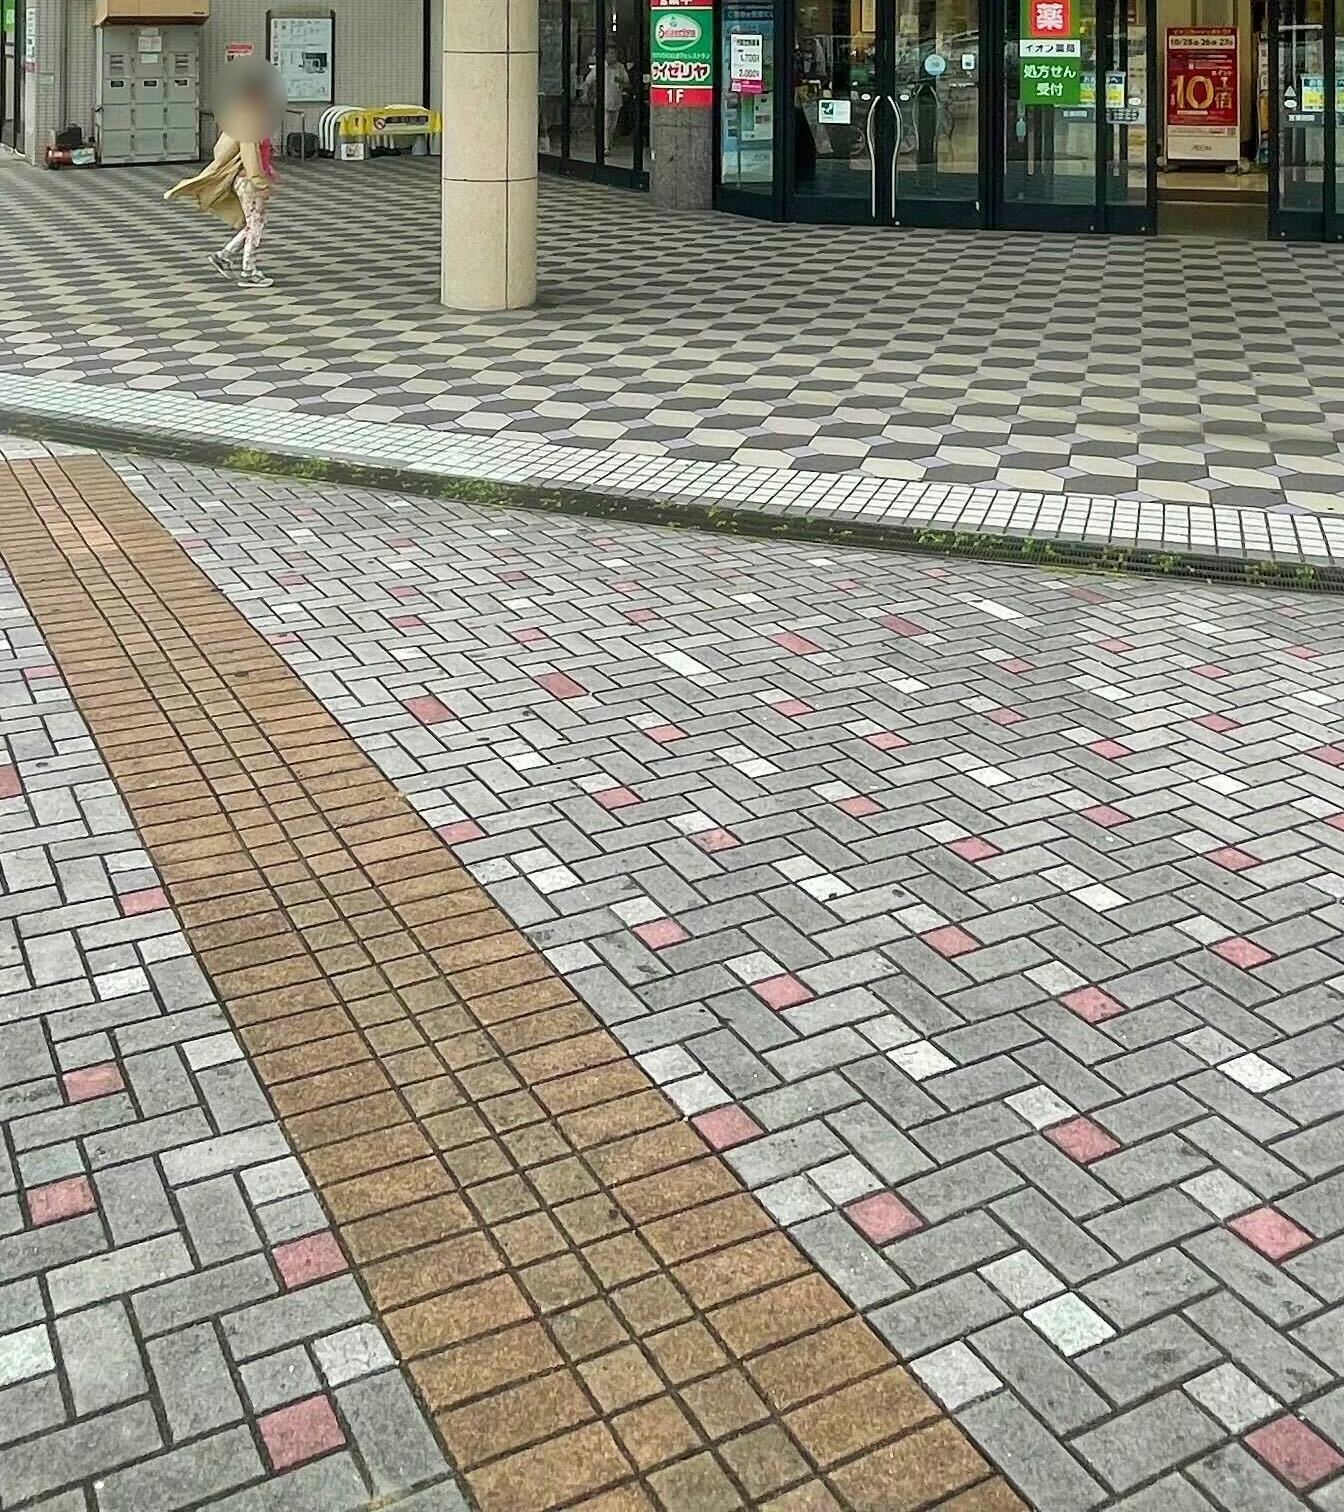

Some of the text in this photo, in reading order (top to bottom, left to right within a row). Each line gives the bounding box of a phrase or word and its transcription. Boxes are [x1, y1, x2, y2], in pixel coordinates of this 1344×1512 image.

[1035, 2, 1064, 30] 薬
[1023, 65, 1077, 78] 処方せん
[667, 89, 684, 104] 1F
[1036, 83, 1064, 96] 受付
